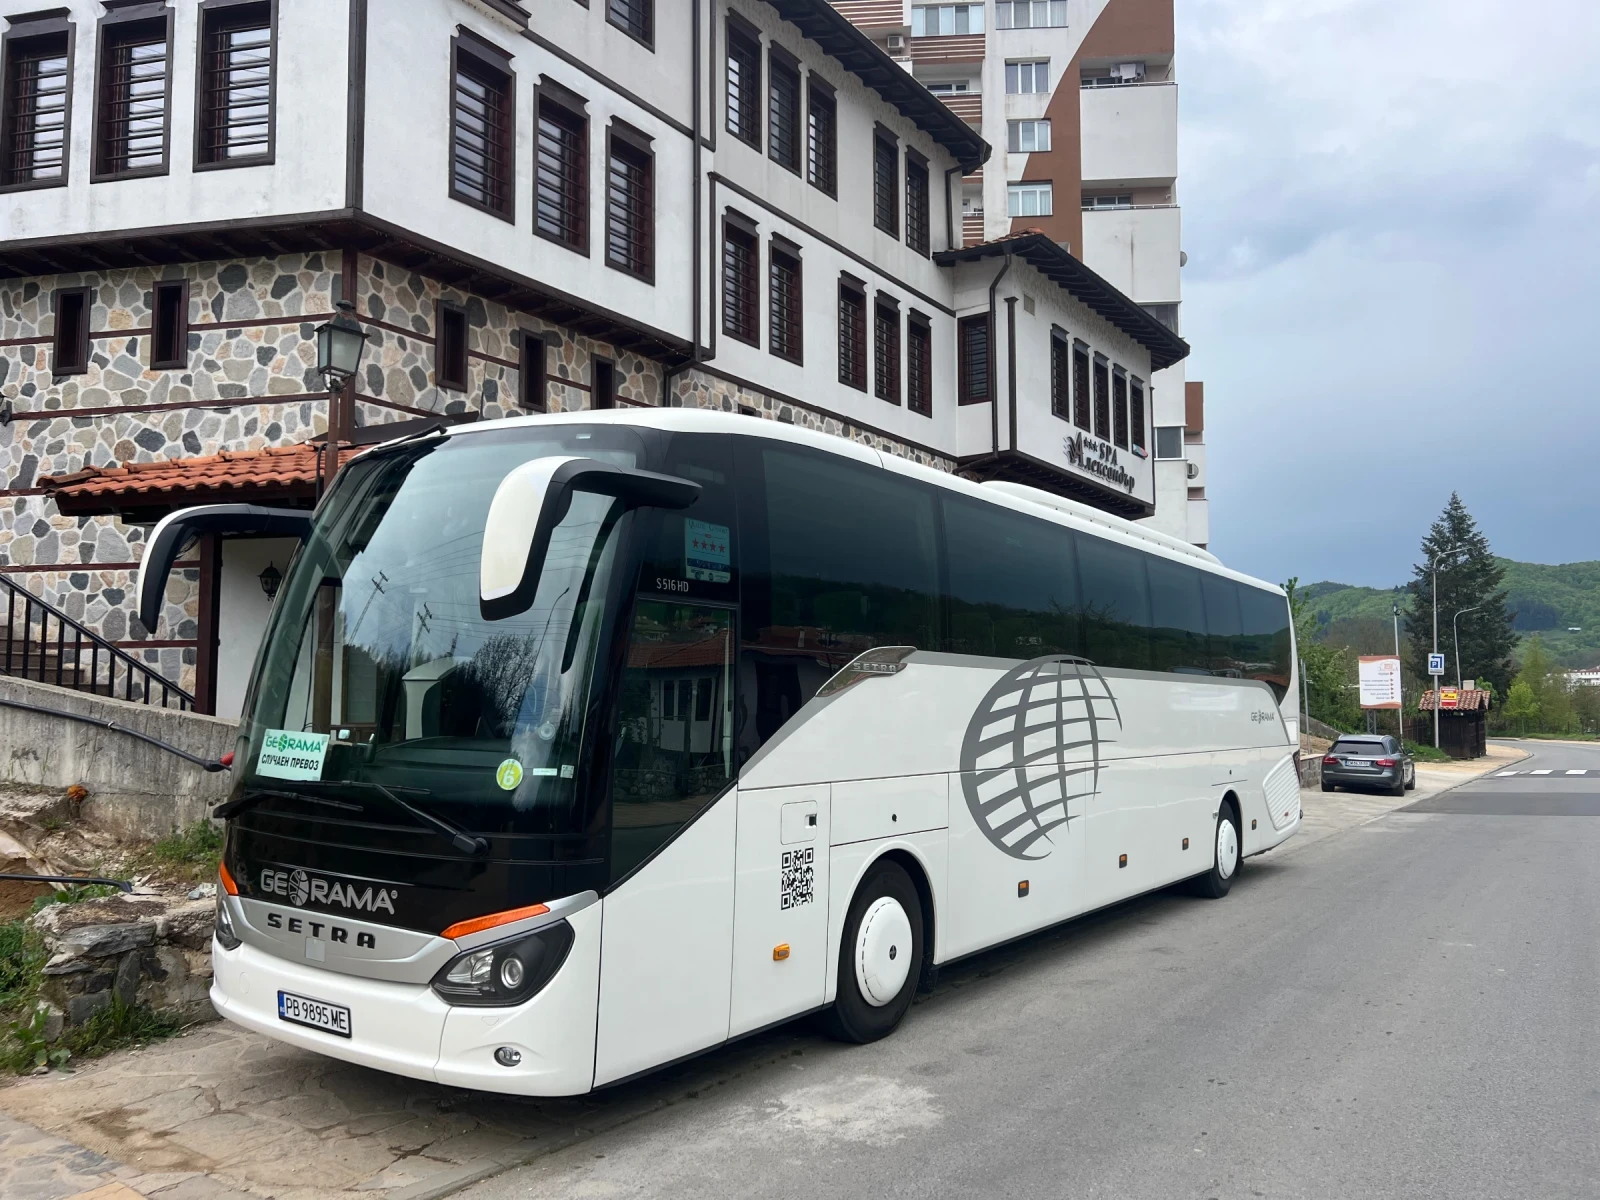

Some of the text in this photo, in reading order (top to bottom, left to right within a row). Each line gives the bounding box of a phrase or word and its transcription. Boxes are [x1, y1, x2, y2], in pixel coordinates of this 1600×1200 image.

[1099, 442, 1118, 467] SPA
[656, 577, 689, 592] S 516 HD
[853, 662, 897, 672] SETRA
[261, 753, 319, 771] СЛУЧАЕН ПРЕВОЗ
[502, 769, 515, 786] 6
[267, 912, 376, 949] SETRA
[285, 997, 347, 1031] PB 9895 ME
